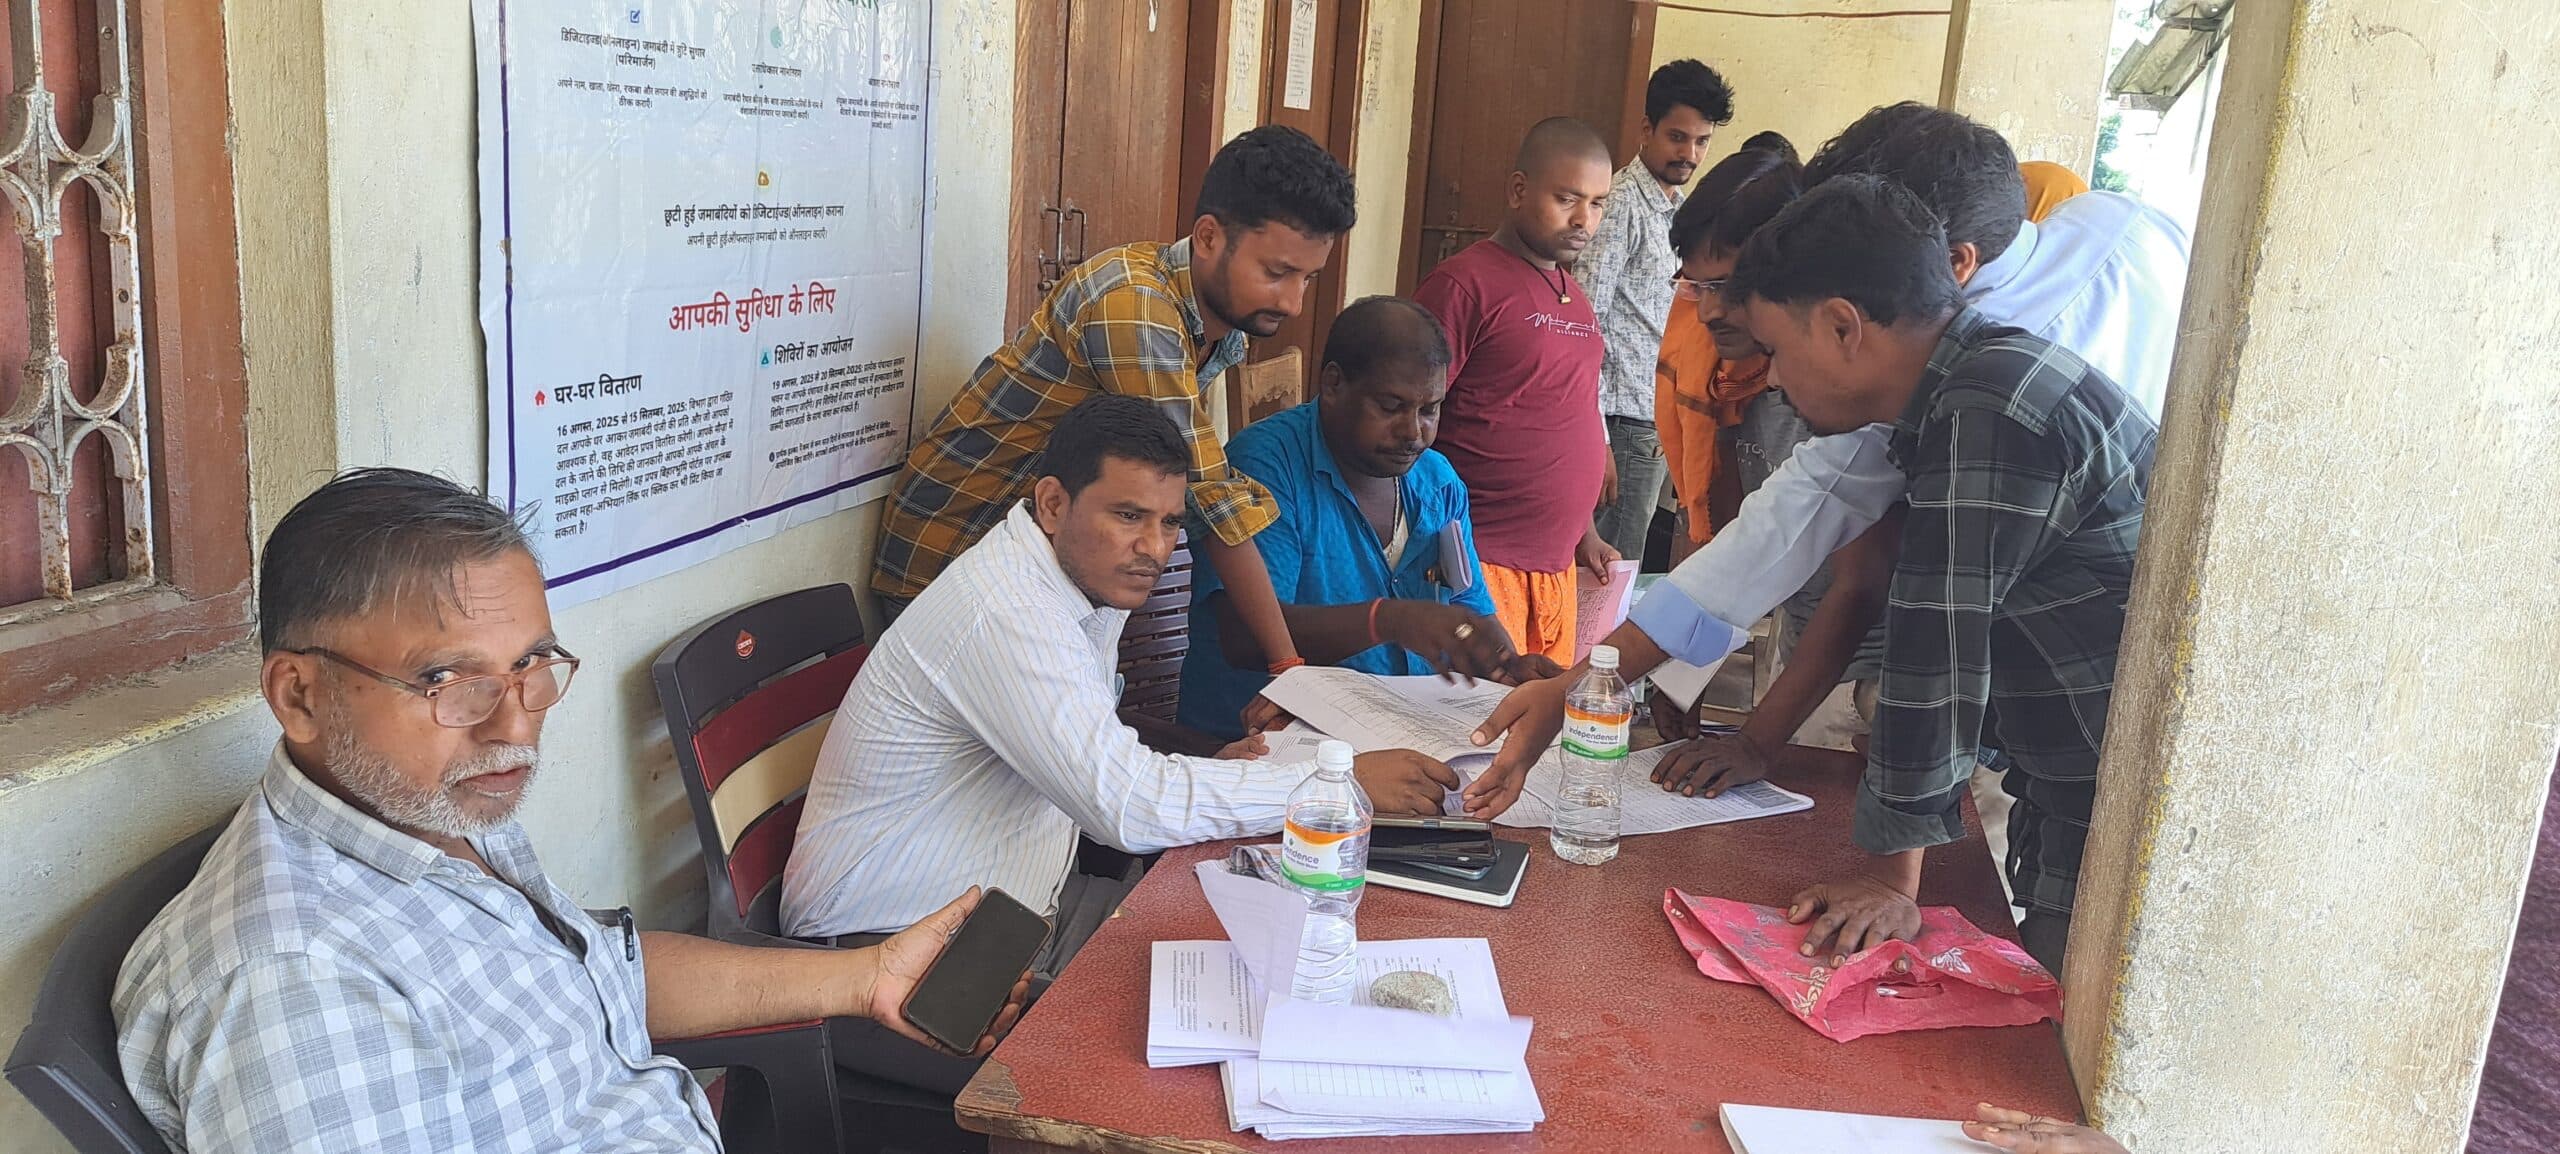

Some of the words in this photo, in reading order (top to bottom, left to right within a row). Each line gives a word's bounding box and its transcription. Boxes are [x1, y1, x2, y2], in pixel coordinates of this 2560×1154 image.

[664, 204, 681, 227] छूटी
[684, 204, 695, 227] हुई
[698, 203, 737, 222] जमाबंदियों
[740, 203, 751, 221] को
[669, 291, 730, 331] आपकी
[788, 284, 804, 316] के
[808, 281, 836, 314] लिए
[774, 341, 804, 365] शिविरों
[807, 344, 818, 359] का
[821, 336, 854, 357] आयोजन
[554, 382, 595, 404] घर-घर
[599, 373, 642, 397] वितरण
[773, 381, 780, 390] 19
[557, 425, 567, 437] 16
[570, 421, 593, 434] अगस्त,
[596, 415, 619, 429] 2025
[621, 411, 627, 424] से
[630, 412, 637, 423] 15
[667, 401, 687, 415] 2025:
[557, 443, 568, 454] दल
[570, 435, 592, 450] आपके
[605, 432, 627, 443] आकर
[555, 477, 567, 488] दल
[568, 472, 576, 484] के
[596, 465, 606, 478] की
[555, 525, 577, 539] सकता
